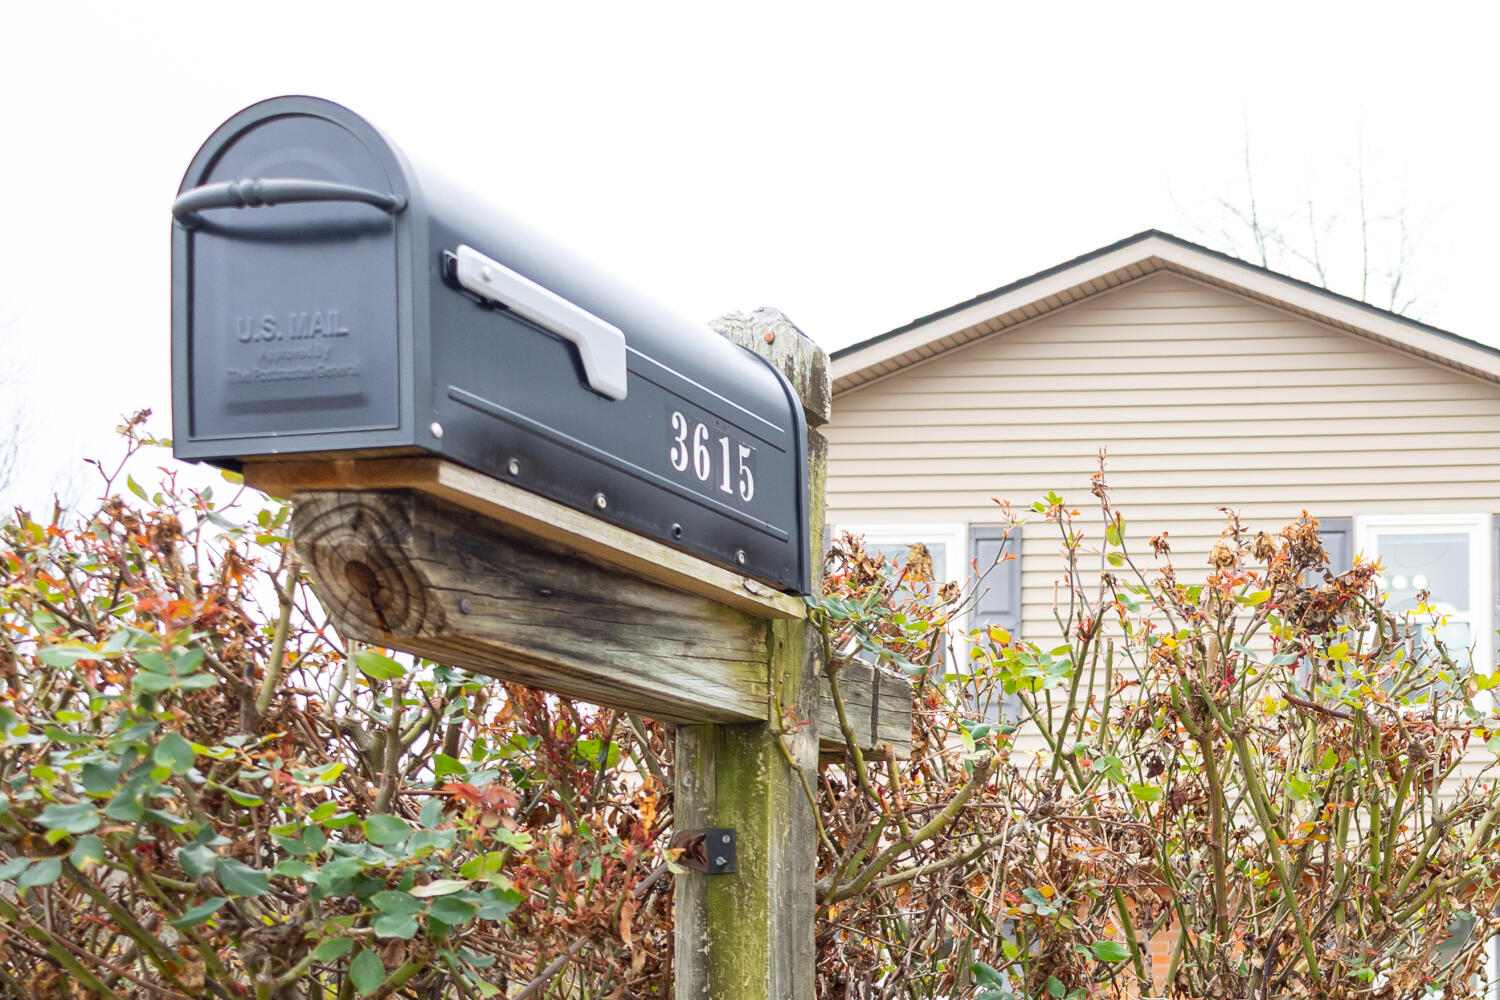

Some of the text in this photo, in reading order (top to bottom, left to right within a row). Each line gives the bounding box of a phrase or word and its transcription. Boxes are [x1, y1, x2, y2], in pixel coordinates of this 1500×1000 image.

[236, 308, 349, 343] U.S. MAIL
[670, 411, 755, 502] 3615
